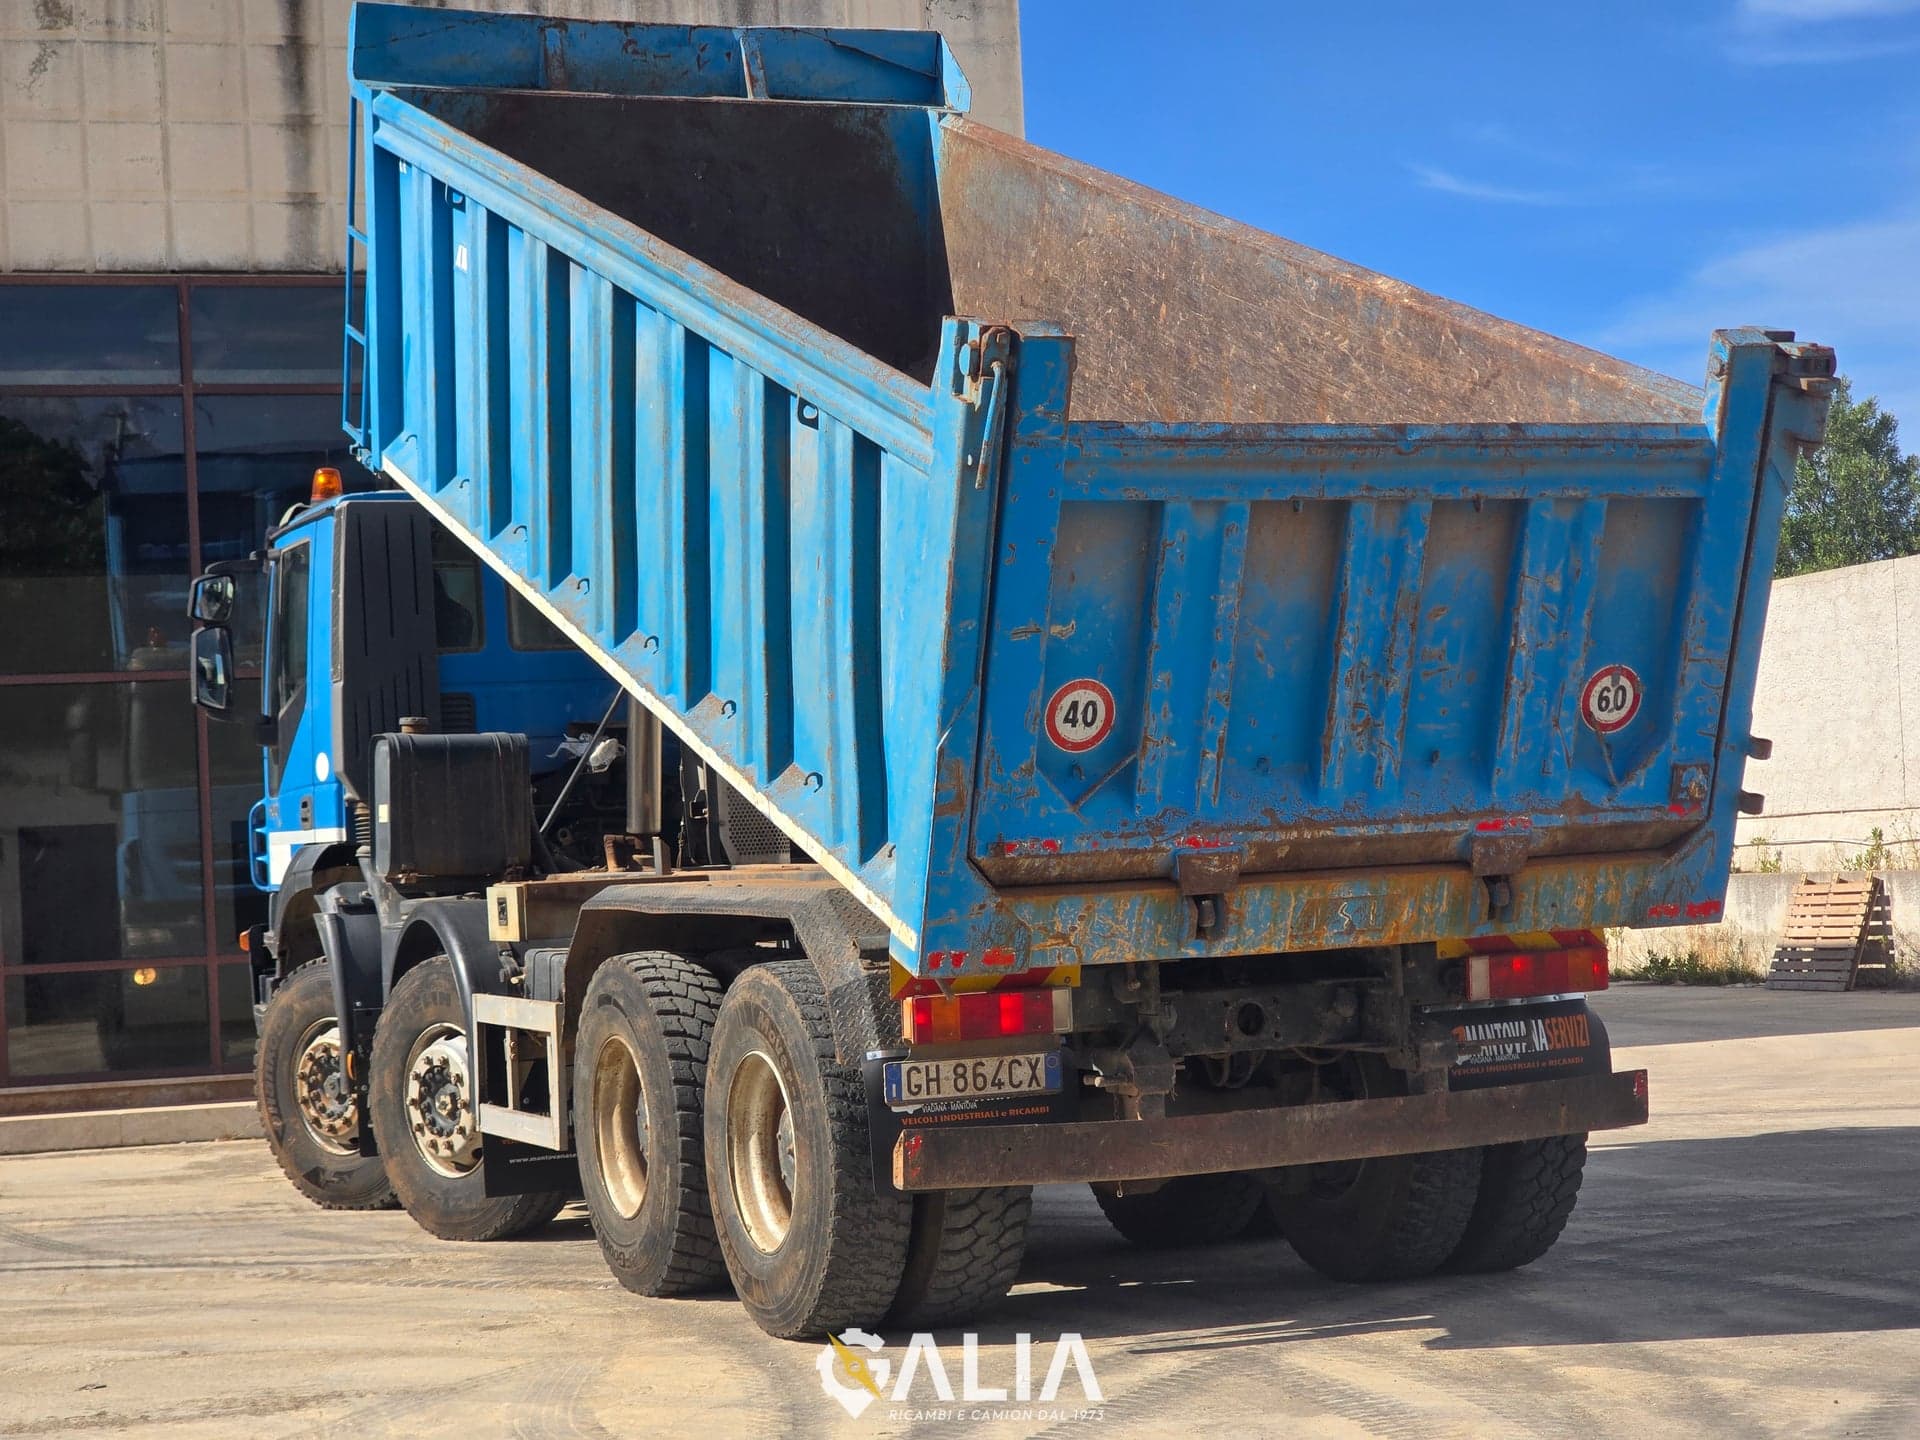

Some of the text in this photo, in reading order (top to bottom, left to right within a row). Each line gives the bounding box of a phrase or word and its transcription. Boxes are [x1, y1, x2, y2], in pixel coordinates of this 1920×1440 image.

[1597, 685, 1627, 712] 60
[1063, 700, 1098, 728] 40
[906, 1064, 942, 1097] GH
[952, 1056, 1042, 1094] 864CX
[901, 1116, 938, 1126] VEICOLI
[940, 1110, 1000, 1123] INDUSTRIALI
[1008, 1105, 1050, 1117] RICAMBI
[950, 1101, 978, 1112] MANTOVA
